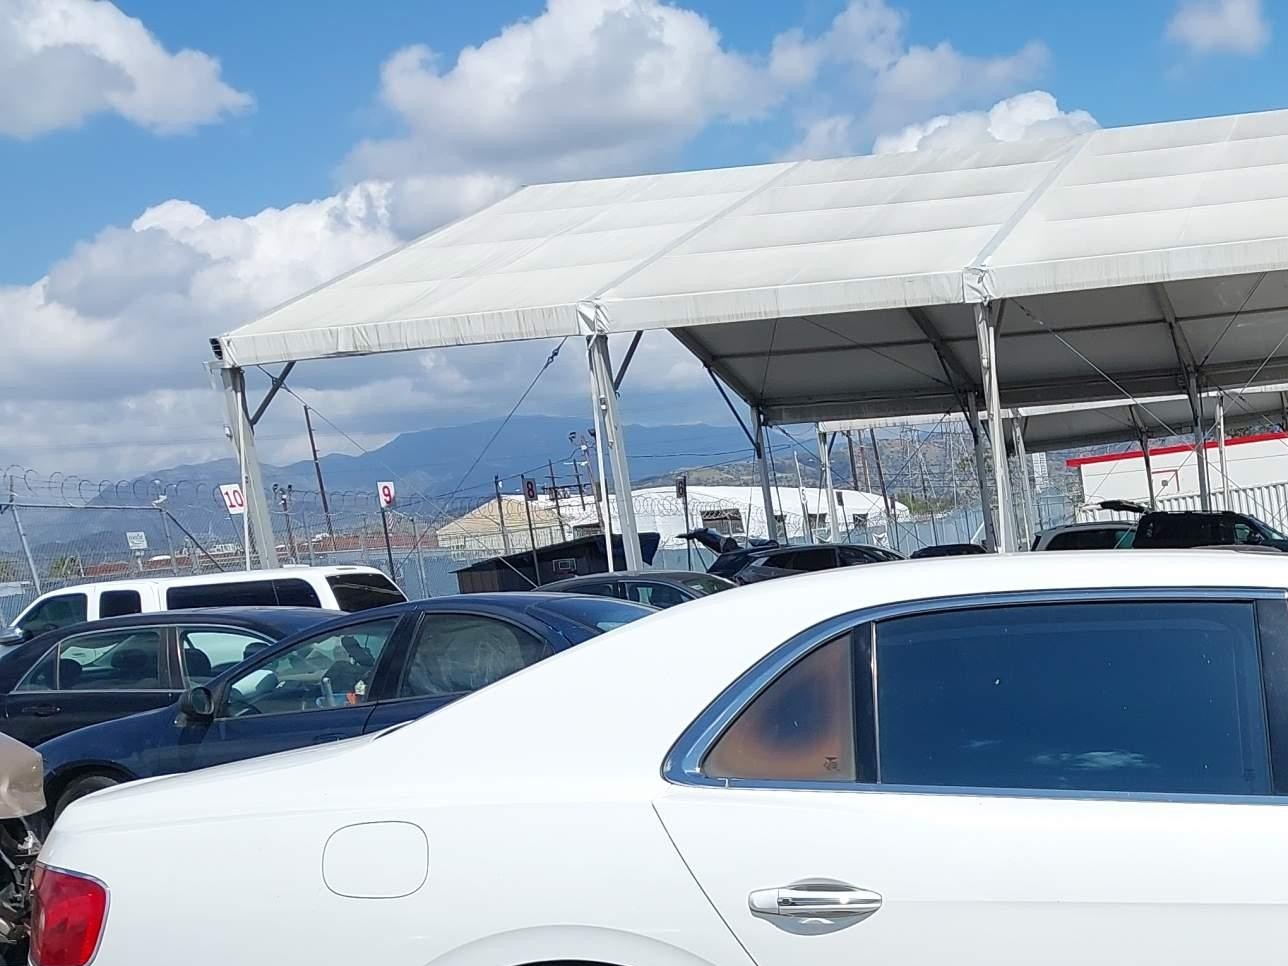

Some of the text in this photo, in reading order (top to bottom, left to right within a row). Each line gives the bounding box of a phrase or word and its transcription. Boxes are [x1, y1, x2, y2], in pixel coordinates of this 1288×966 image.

[224, 489, 245, 508] 10
[382, 485, 392, 505] 9
[526, 481, 535, 499] 8
